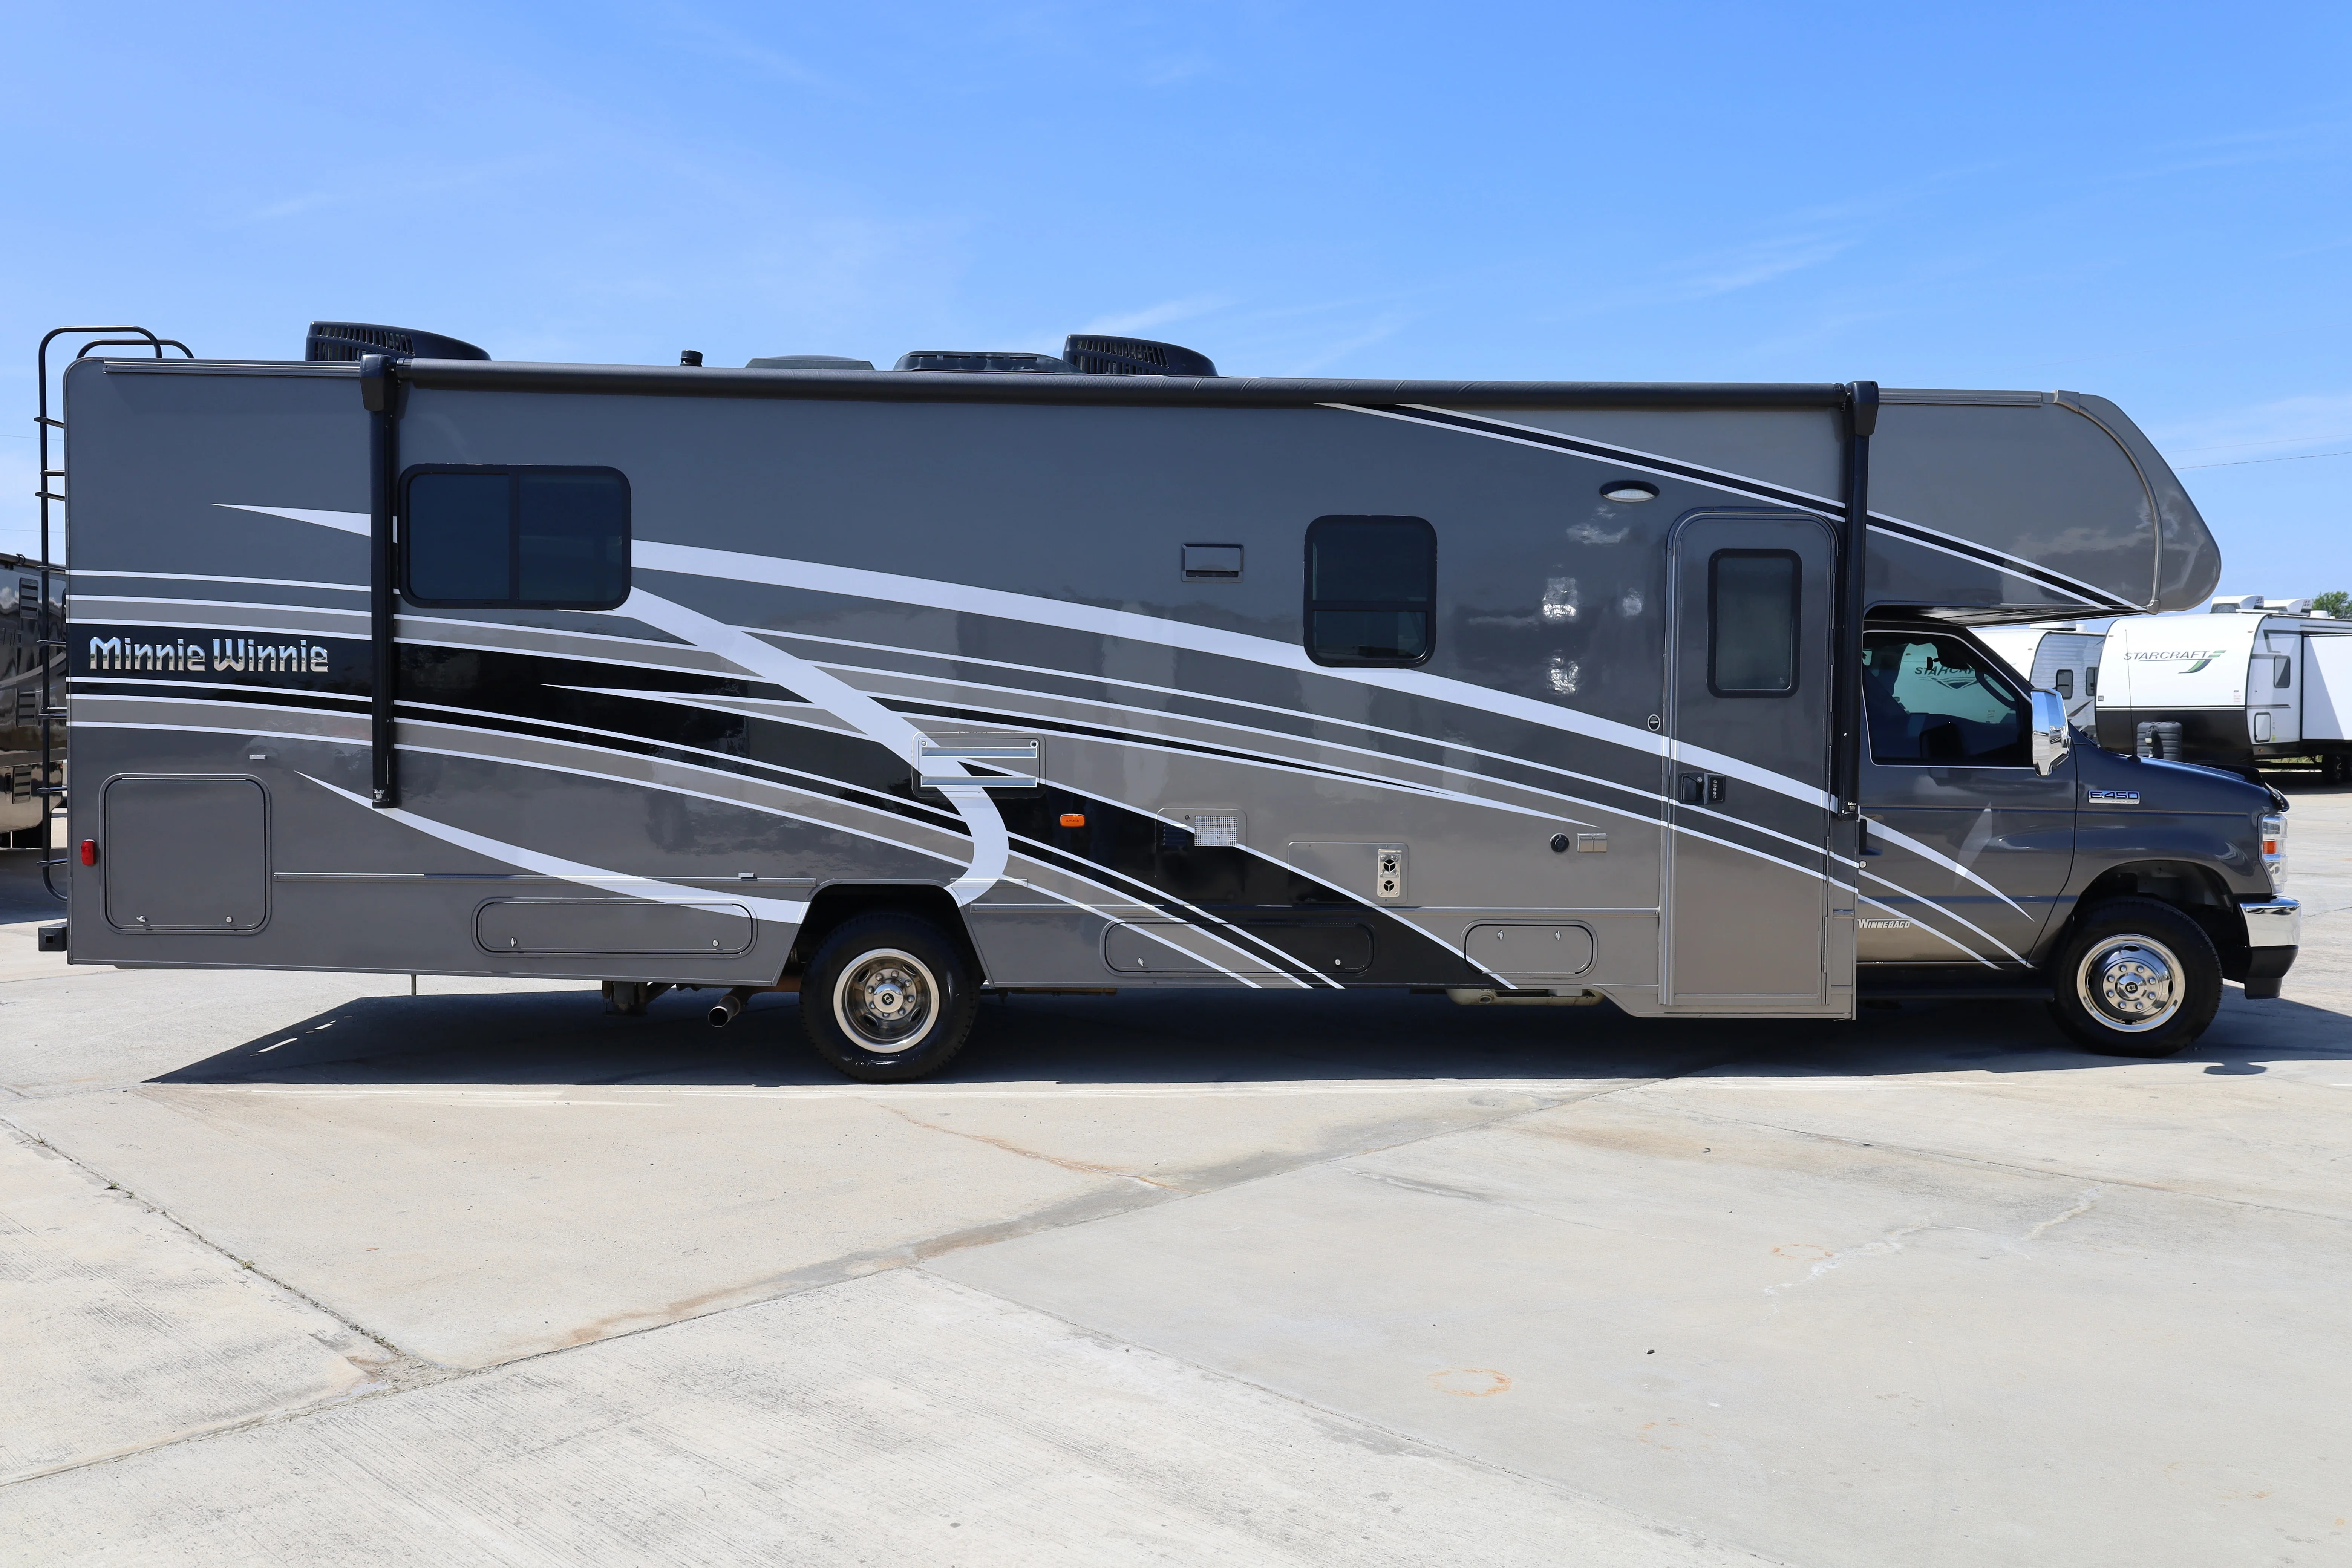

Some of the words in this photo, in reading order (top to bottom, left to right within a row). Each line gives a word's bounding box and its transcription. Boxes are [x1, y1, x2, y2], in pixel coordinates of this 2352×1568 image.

[90, 637, 206, 671] Minnie
[213, 639, 329, 672] Winnie
[2124, 651, 2210, 660] STARCRAFT
